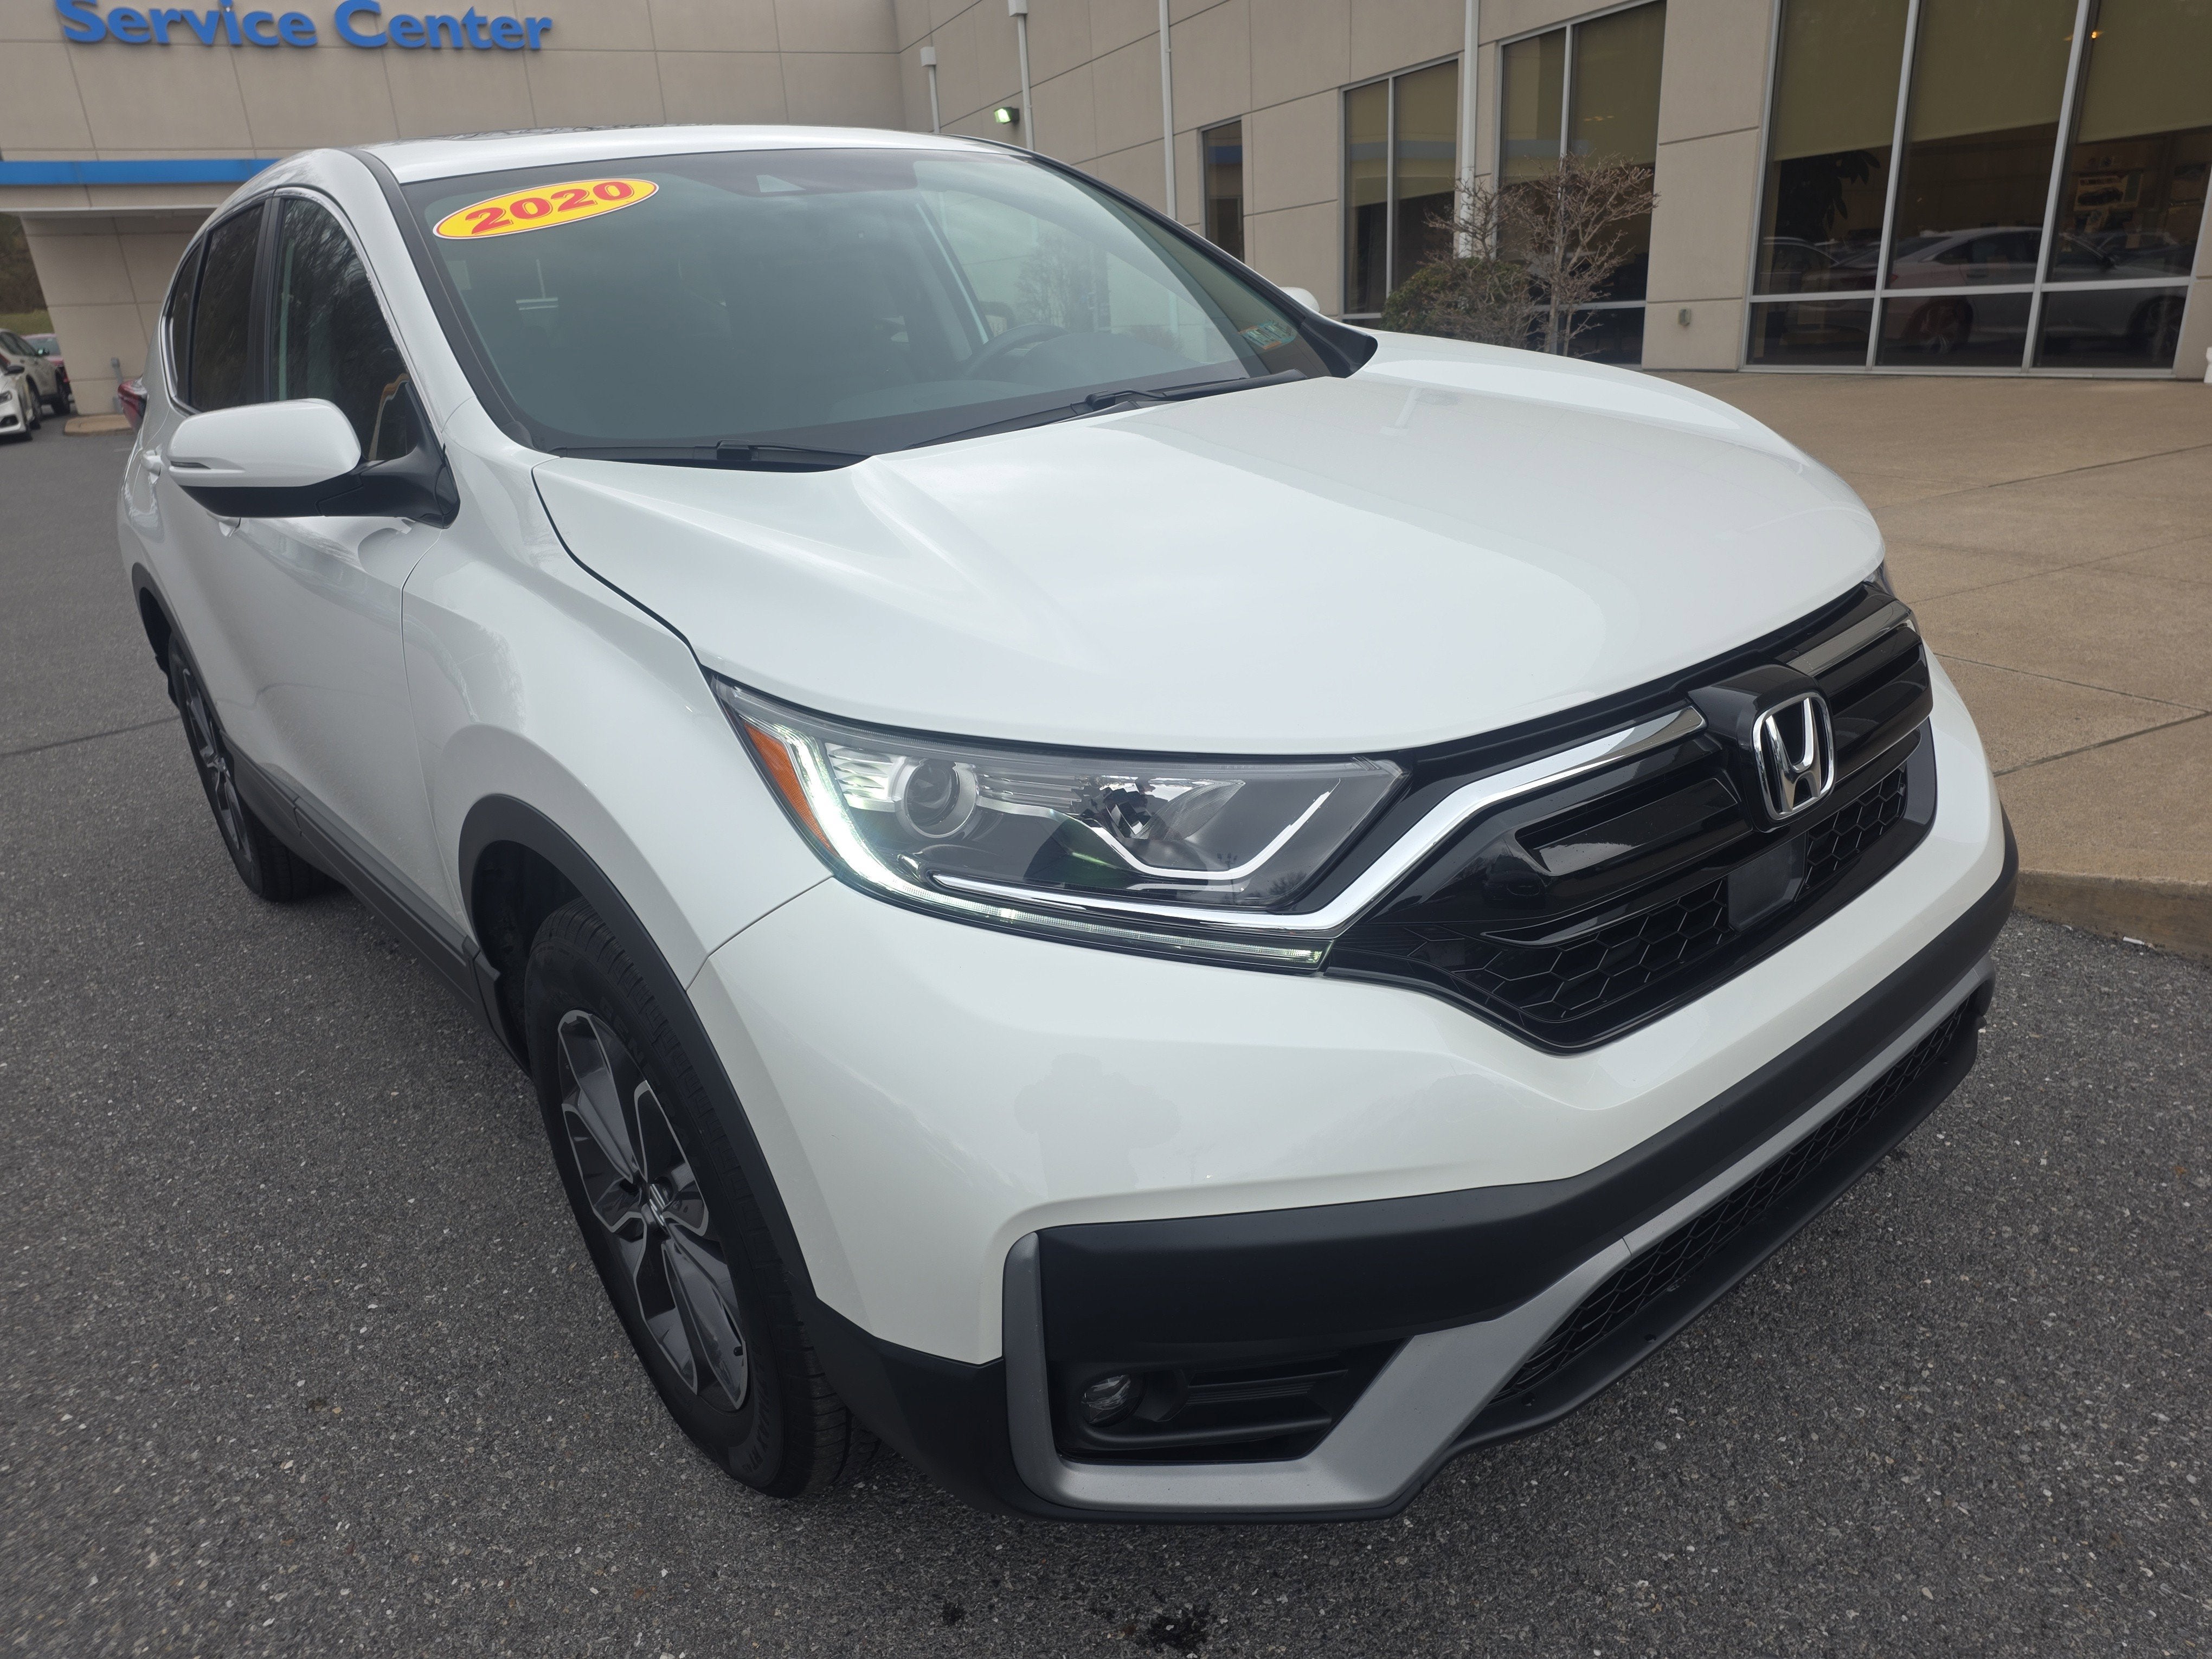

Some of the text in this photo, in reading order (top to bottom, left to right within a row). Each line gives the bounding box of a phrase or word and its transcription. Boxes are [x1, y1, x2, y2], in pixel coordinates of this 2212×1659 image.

[55, 0, 553, 50] Service Center
[465, 182, 635, 235] 2020
